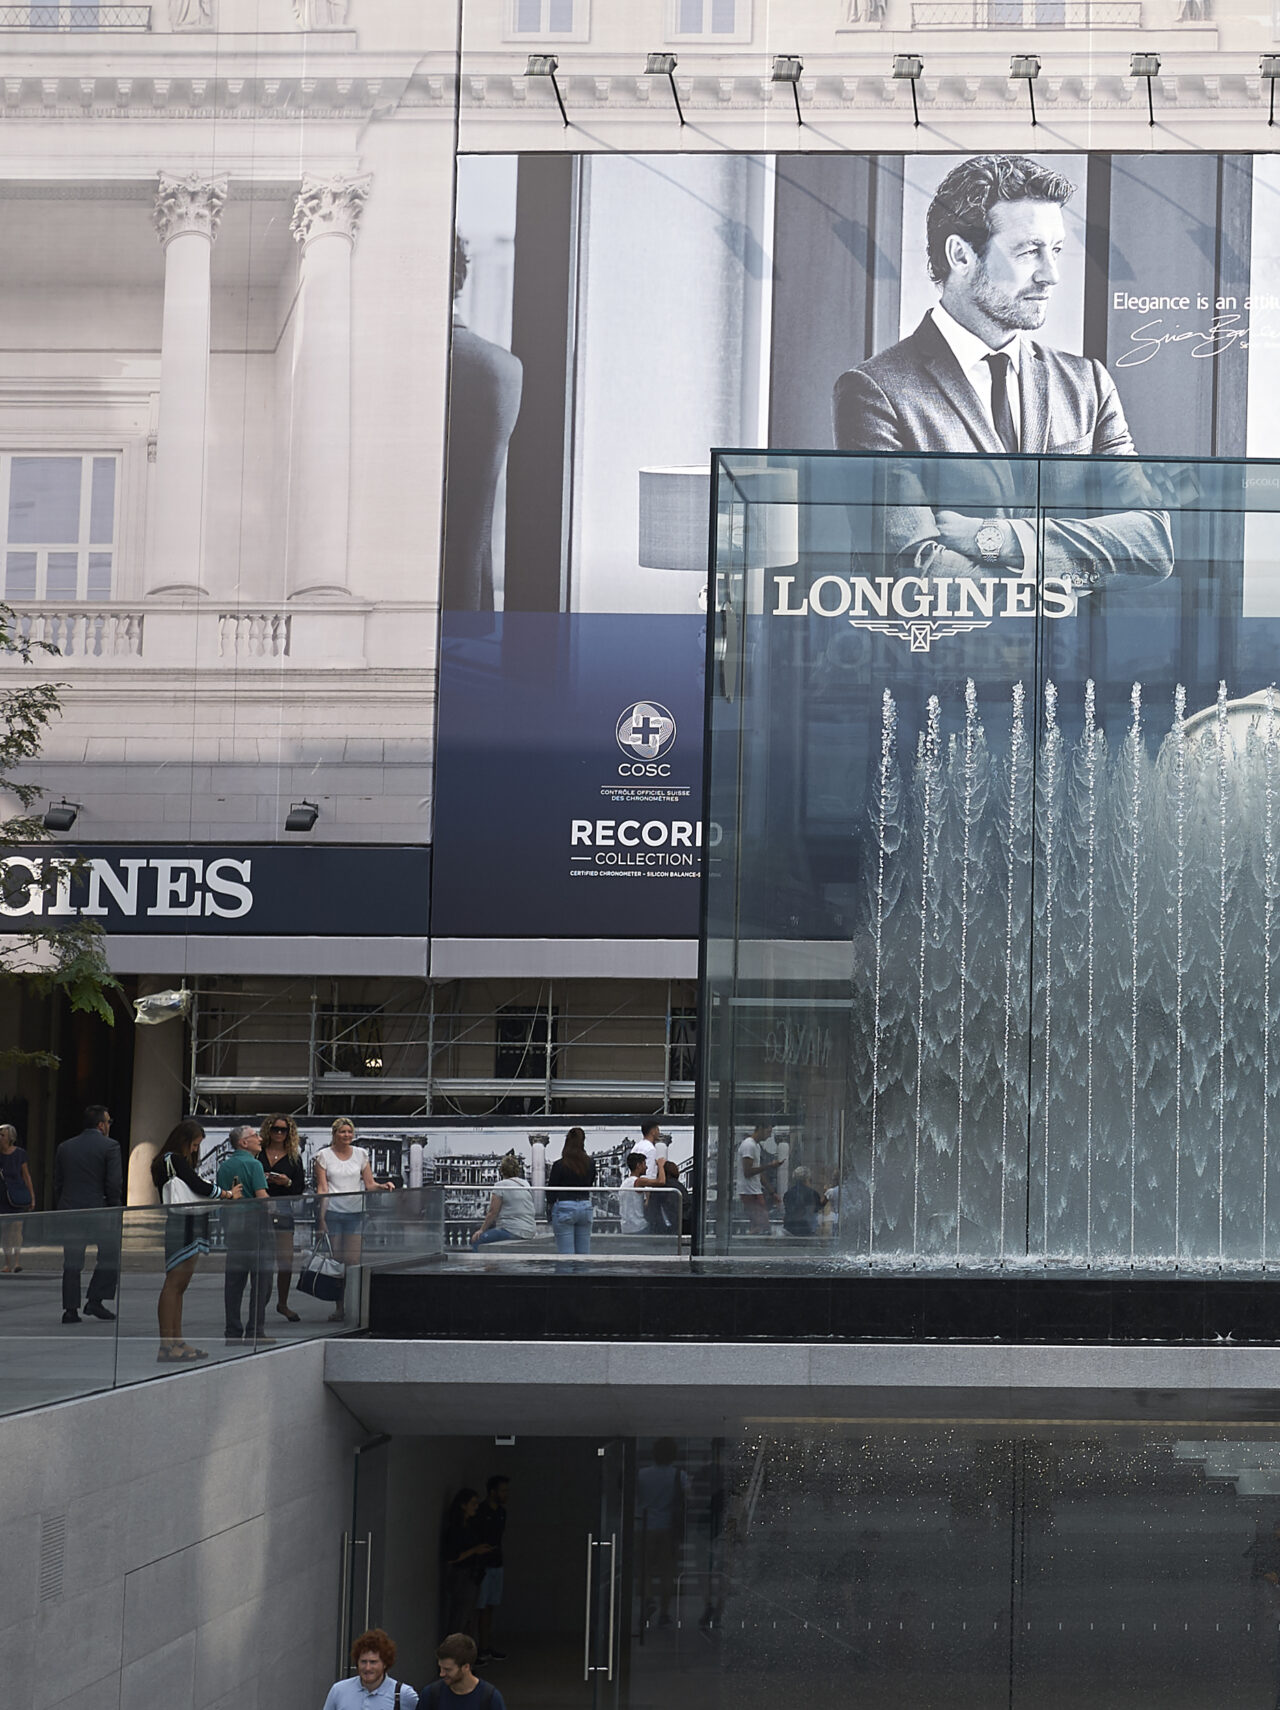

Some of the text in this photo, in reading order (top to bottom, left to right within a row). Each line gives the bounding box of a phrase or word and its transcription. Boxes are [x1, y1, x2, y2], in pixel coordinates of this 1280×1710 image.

[1113, 292, 1190, 313] Elegance
[1196, 293, 1208, 310] is
[1215, 296, 1237, 310] an
[772, 575, 1076, 618] LONGINES
[618, 763, 671, 777] COSC
[600, 788, 635, 796] CONTRÔLE
[595, 852, 693, 866] COLLECTION
